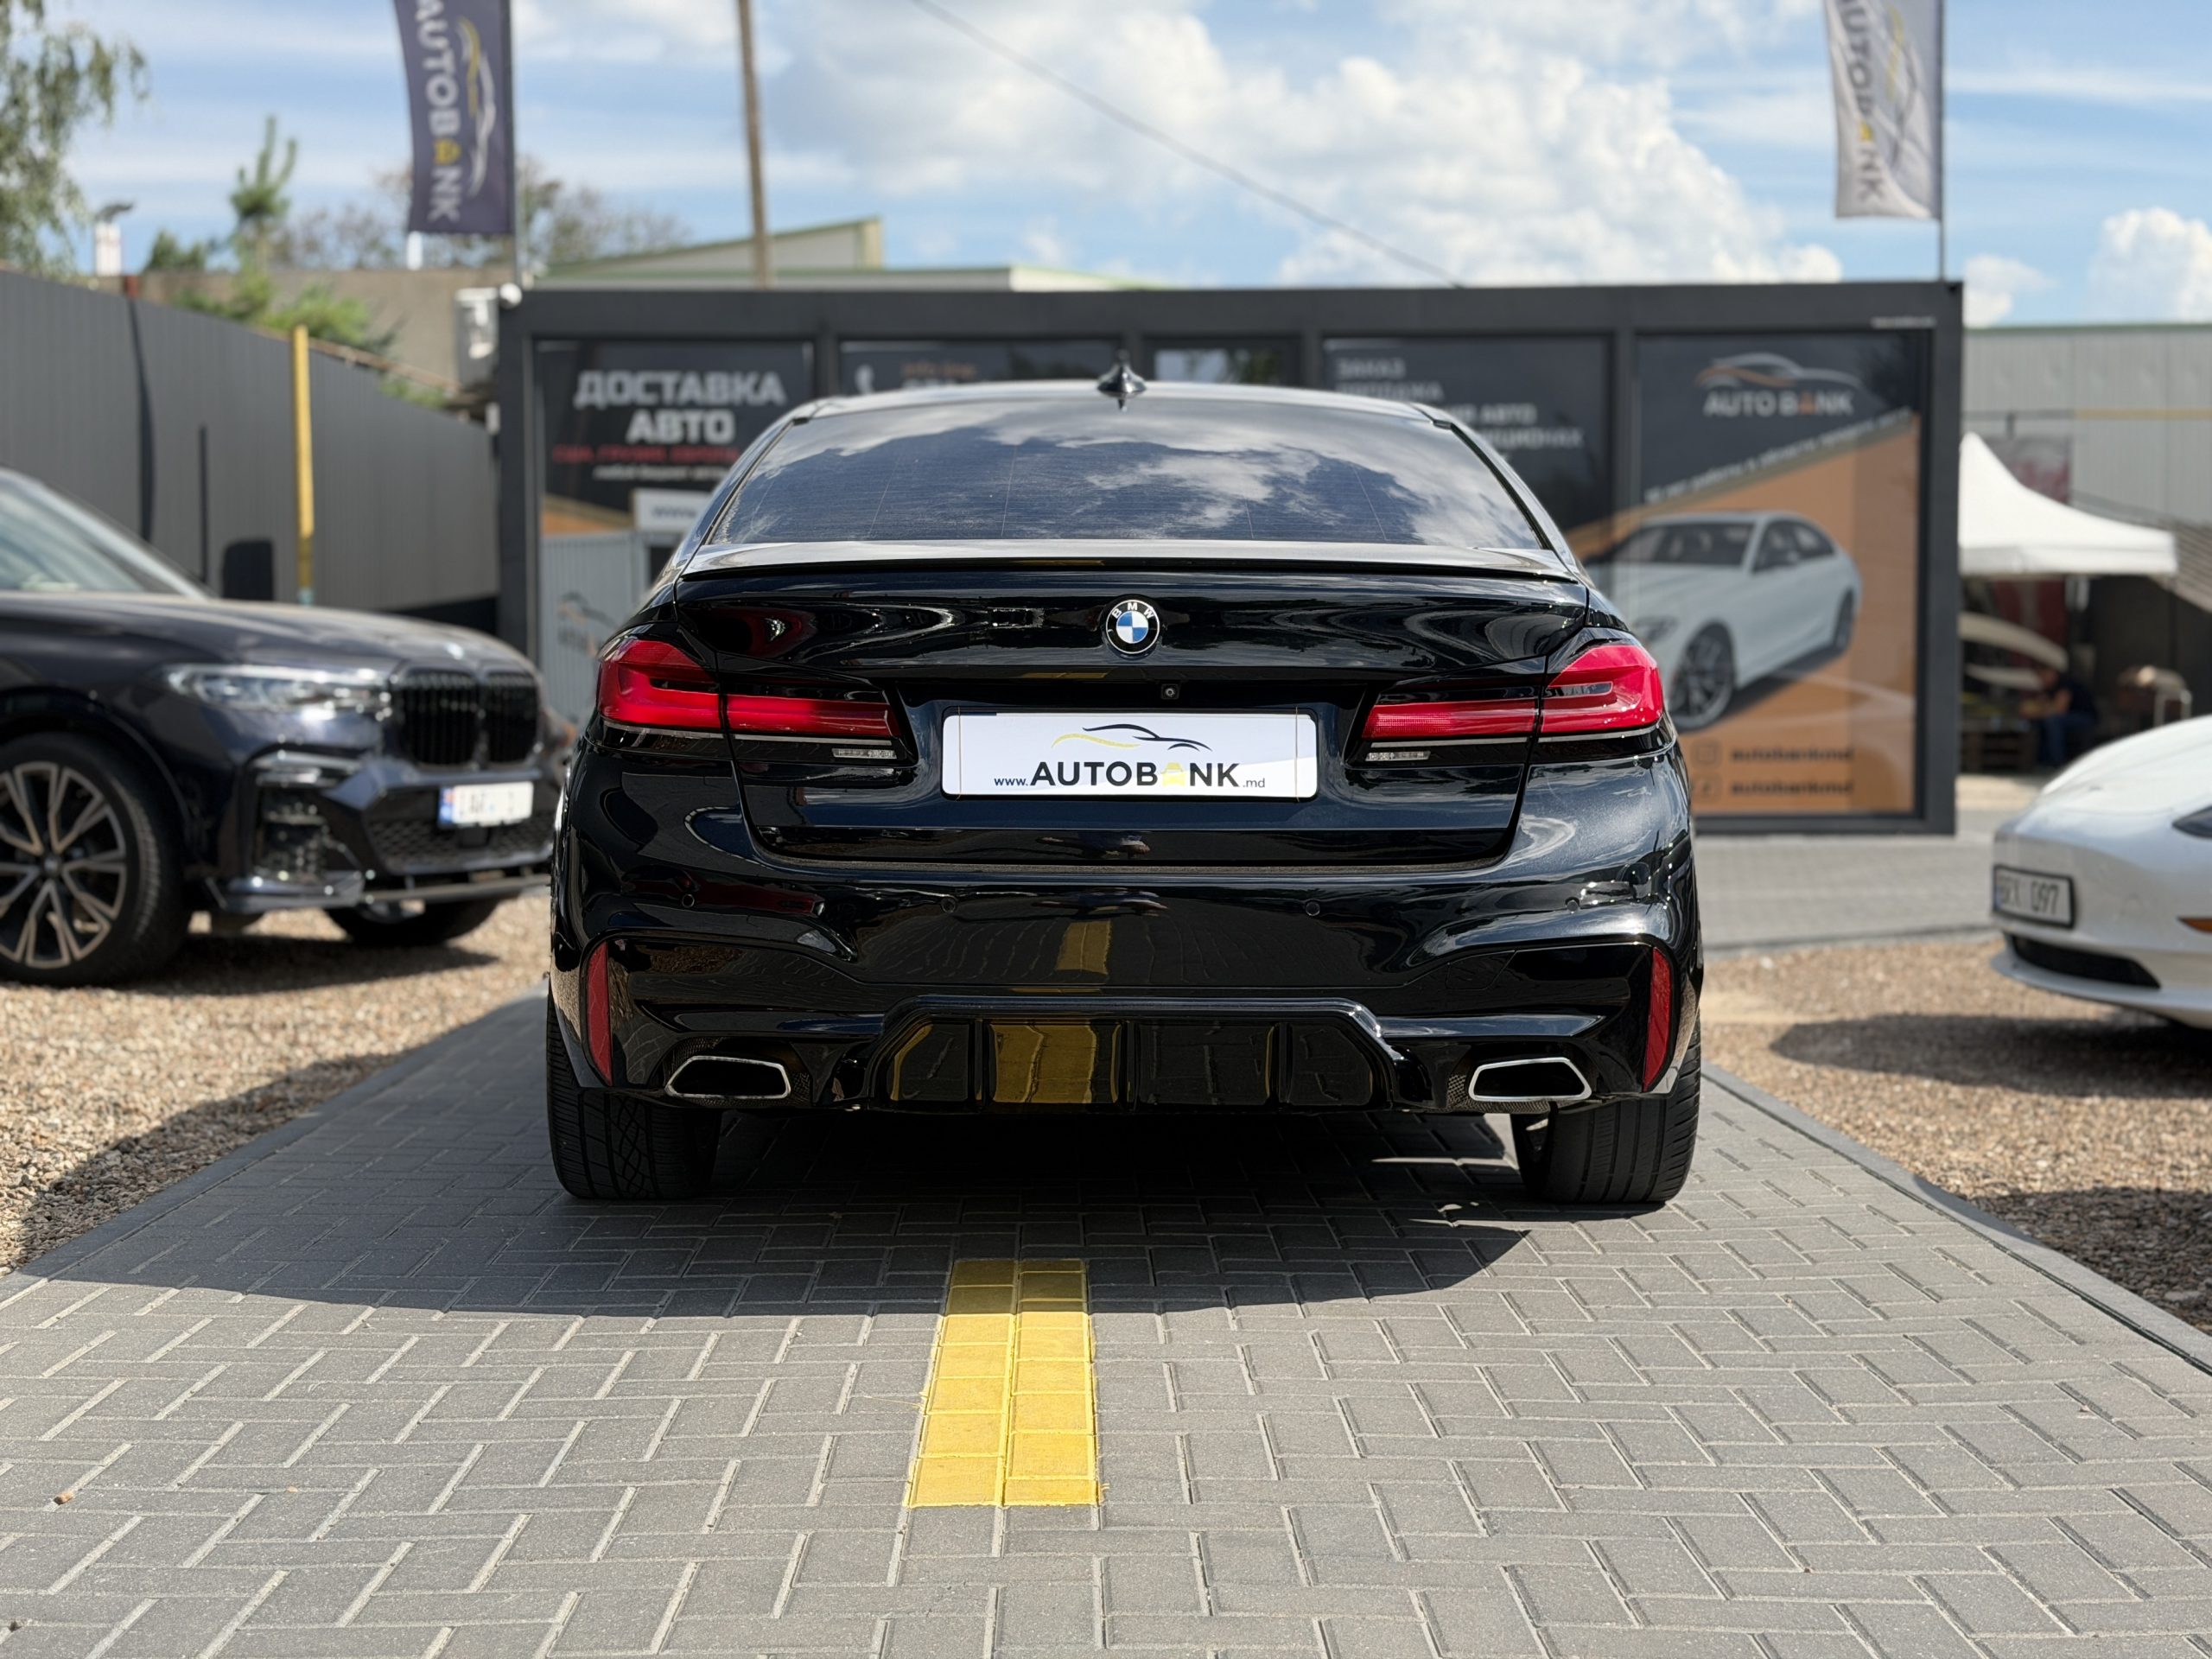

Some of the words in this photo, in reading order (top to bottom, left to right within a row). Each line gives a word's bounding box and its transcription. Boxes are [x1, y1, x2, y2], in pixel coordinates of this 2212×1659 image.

[573, 370, 787, 409] ДОСТАВКА
[626, 410, 736, 444] АВТО
[1112, 602, 1154, 619] BMW
